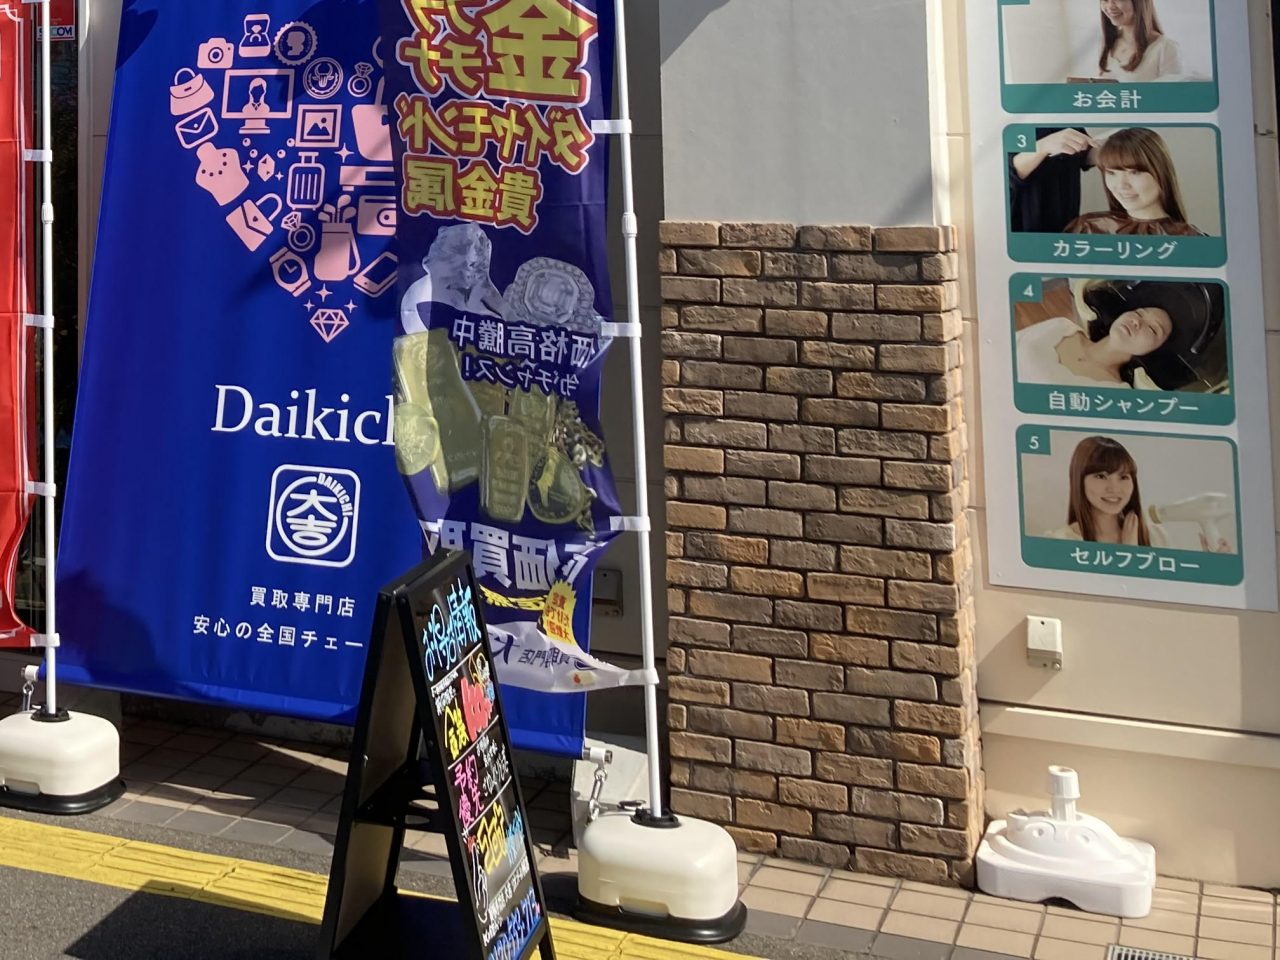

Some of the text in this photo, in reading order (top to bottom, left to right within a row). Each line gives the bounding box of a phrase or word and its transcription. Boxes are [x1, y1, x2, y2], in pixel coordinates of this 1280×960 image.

[1072, 89, 1142, 109] お会計
[1016, 133, 1027, 149] 3
[1053, 239, 1178, 261] カラーリング
[1023, 284, 1035, 298] 4
[1048, 390, 1199, 414] 自動シャンプー
[1029, 435, 1040, 449] 5
[317, 472, 354, 517] DAIKICHI
[286, 489, 338, 547] 大吉
[1070, 546, 1200, 574] セルフブロー
[250, 585, 356, 619] 買取専門店
[193, 614, 364, 651] 安心の全国チェー
